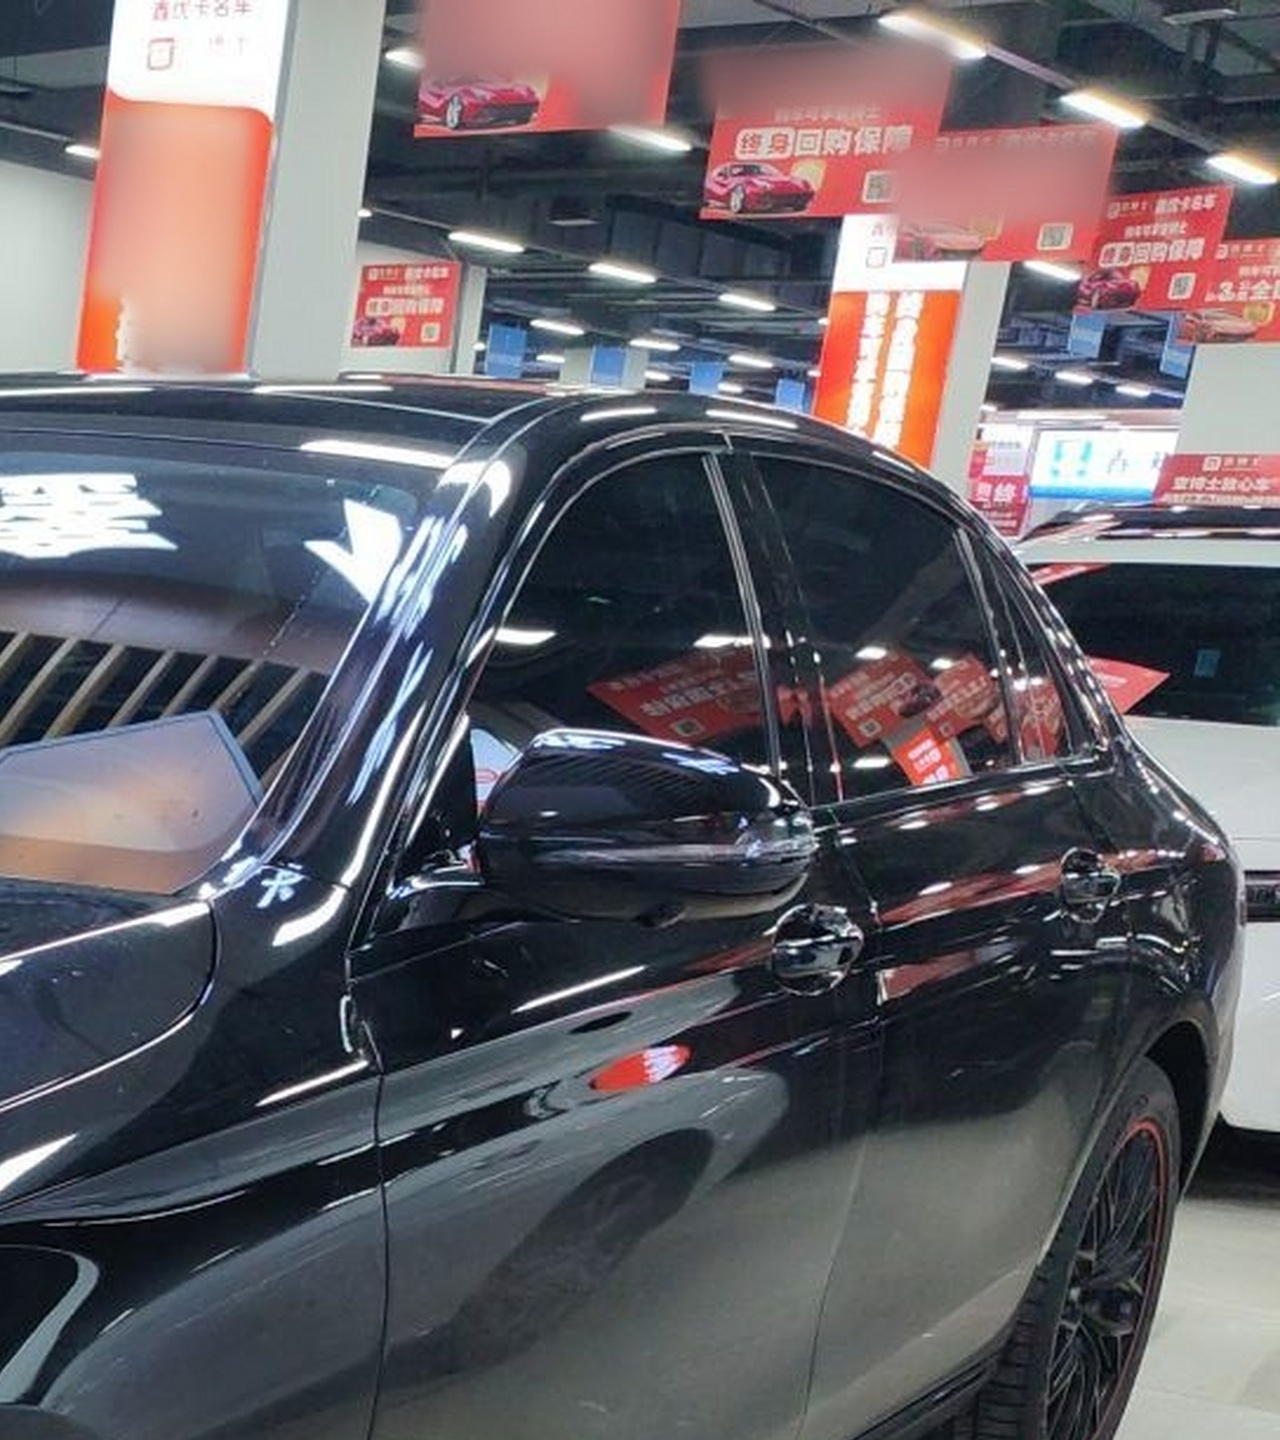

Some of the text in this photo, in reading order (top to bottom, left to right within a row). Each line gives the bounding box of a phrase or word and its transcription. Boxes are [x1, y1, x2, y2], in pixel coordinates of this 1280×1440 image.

[738, 124, 913, 157] 终身回购保障
